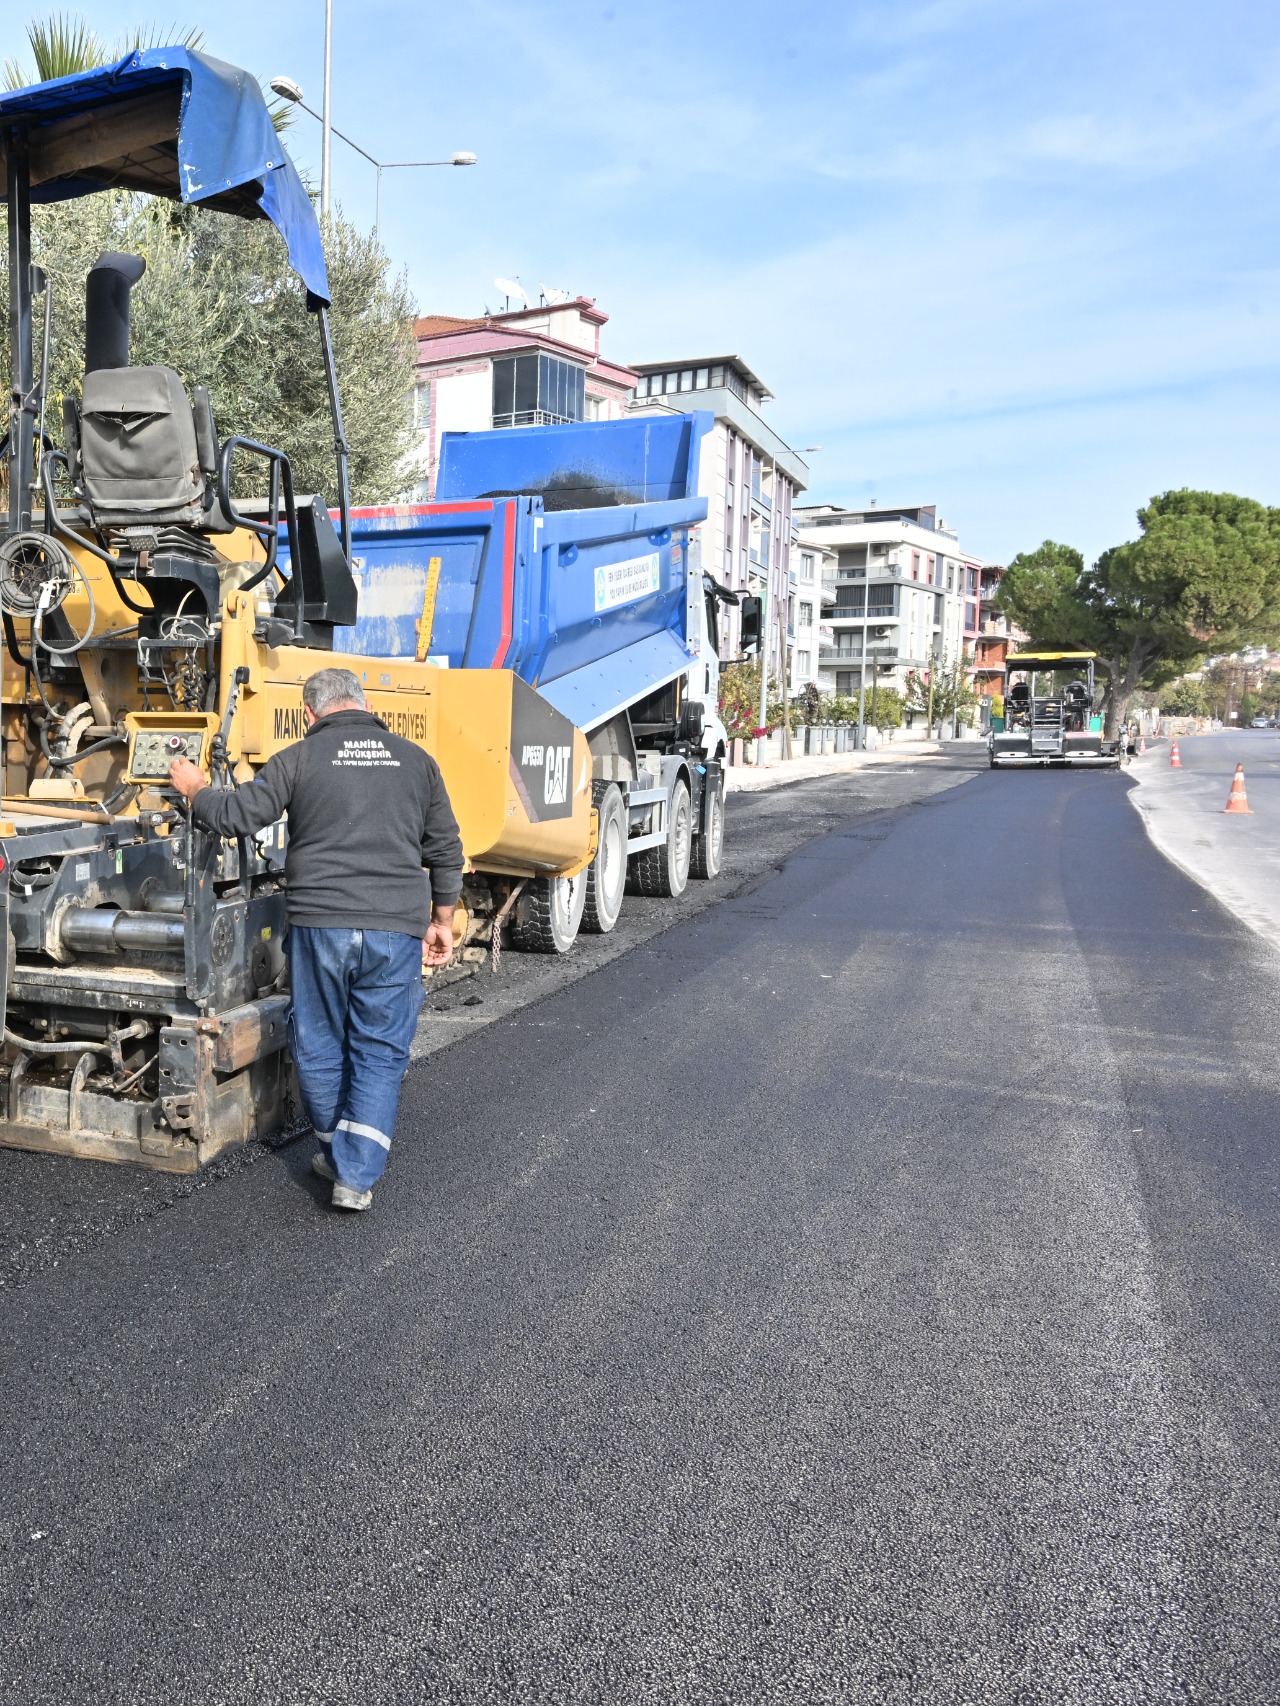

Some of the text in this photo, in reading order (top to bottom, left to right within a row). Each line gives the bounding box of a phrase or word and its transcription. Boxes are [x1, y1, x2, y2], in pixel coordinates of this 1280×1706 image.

[274, 701, 309, 739] MANİS
[338, 749, 392, 759] BÜYÜKŞEHİR
[344, 739, 384, 749] MANİSA
[544, 746, 571, 805] CAT
